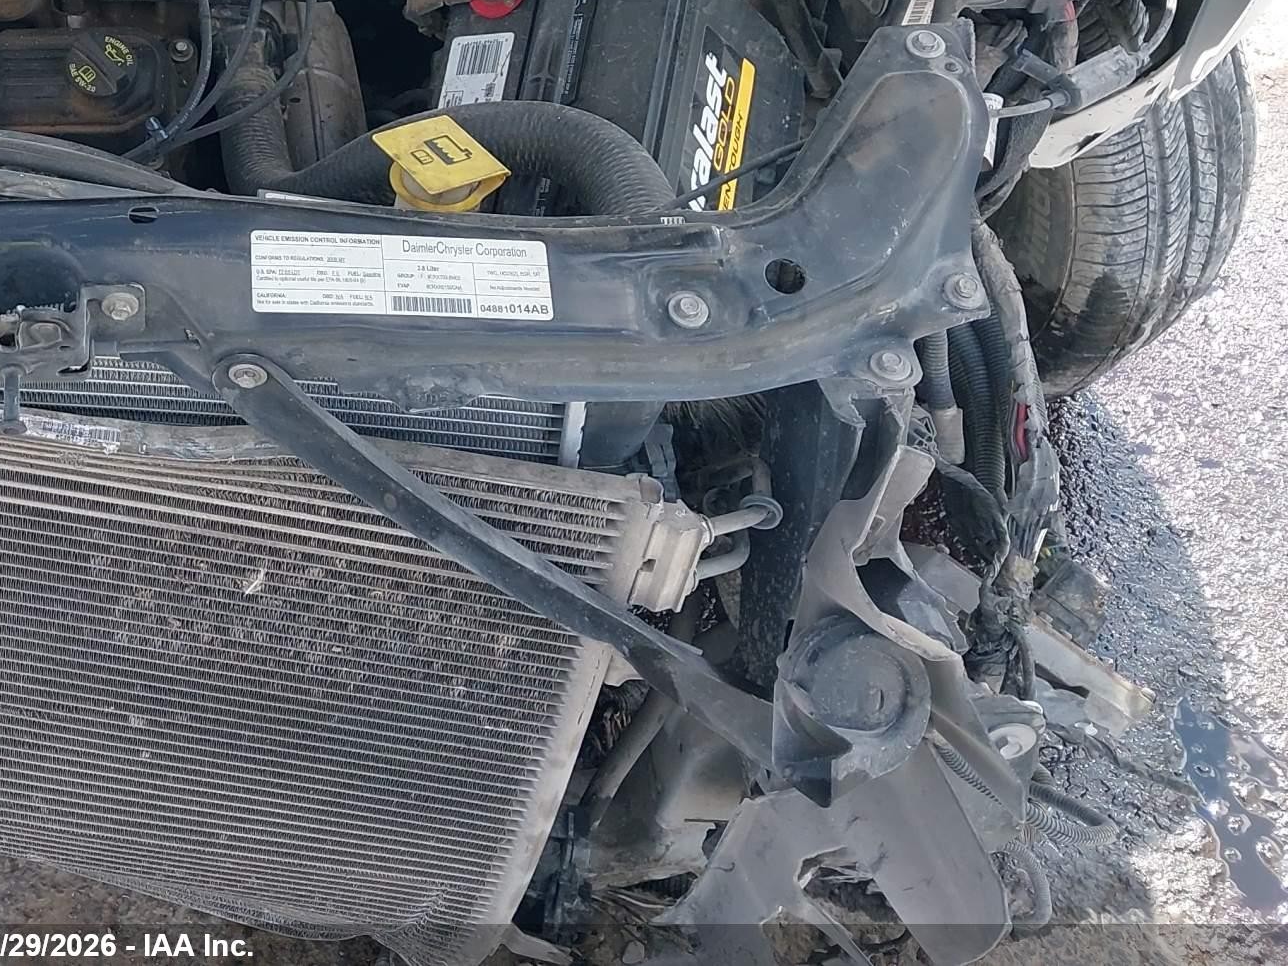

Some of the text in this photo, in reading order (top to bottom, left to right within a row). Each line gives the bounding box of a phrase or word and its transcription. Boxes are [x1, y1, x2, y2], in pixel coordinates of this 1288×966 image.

[104, 36, 134, 67] ENGINE OIL
[74, 76, 96, 93] 5W-20
[688, 52, 728, 212] ralast
[713, 76, 735, 173] GOLD
[728, 110, 744, 171] OUGH
[402, 239, 527, 258] DaimlerChrysler Corporation
[480, 303, 549, 315] 04881014AB
